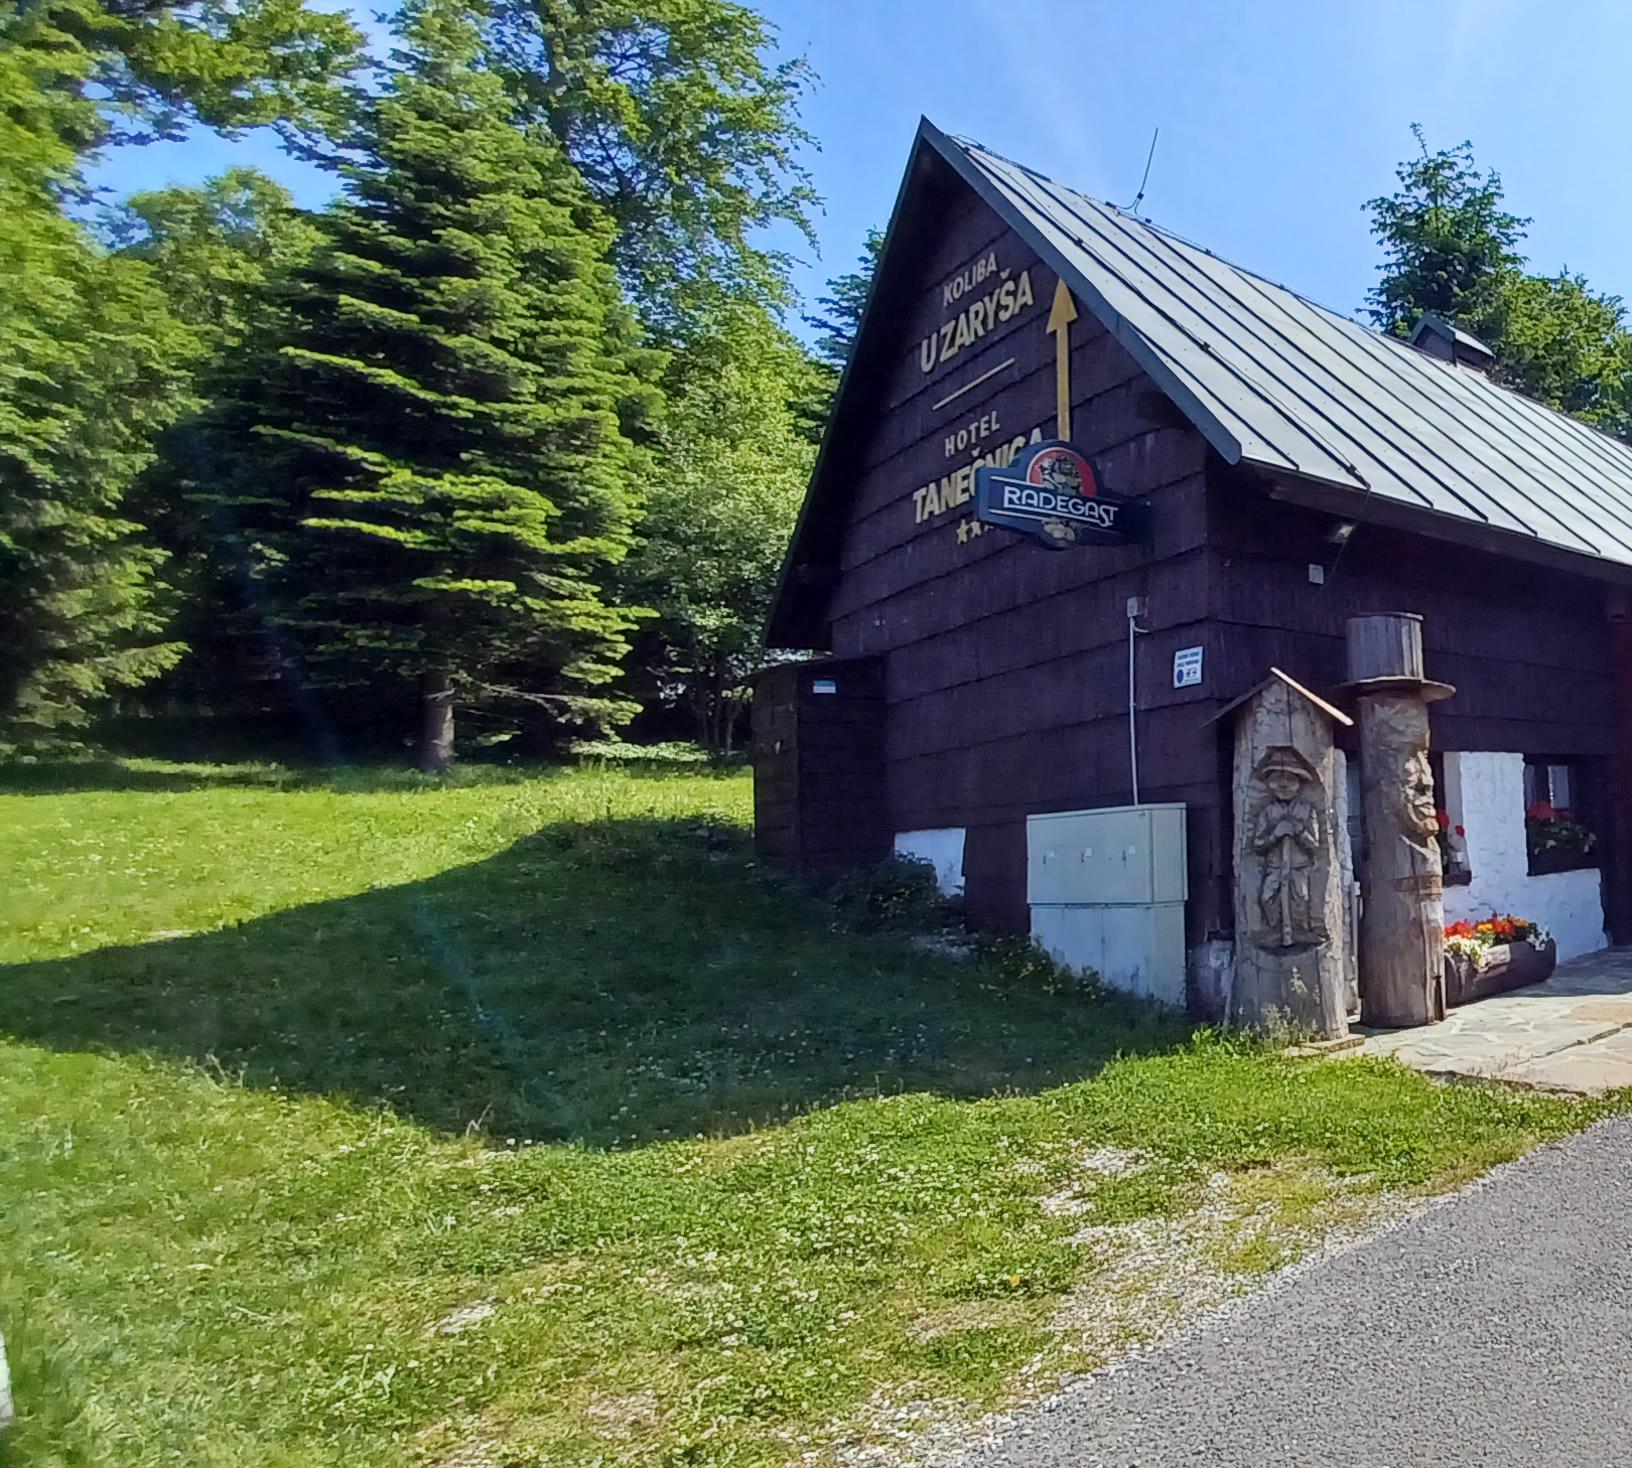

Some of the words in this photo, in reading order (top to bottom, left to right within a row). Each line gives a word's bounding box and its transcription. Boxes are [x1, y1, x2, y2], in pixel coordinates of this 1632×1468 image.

[943, 252, 998, 307] KOLIBA
[920, 332, 938, 373] U
[939, 267, 1034, 363] ZARYŠA
[944, 411, 1000, 457] HOTEL
[1003, 486, 1119, 527] RADEGAST
